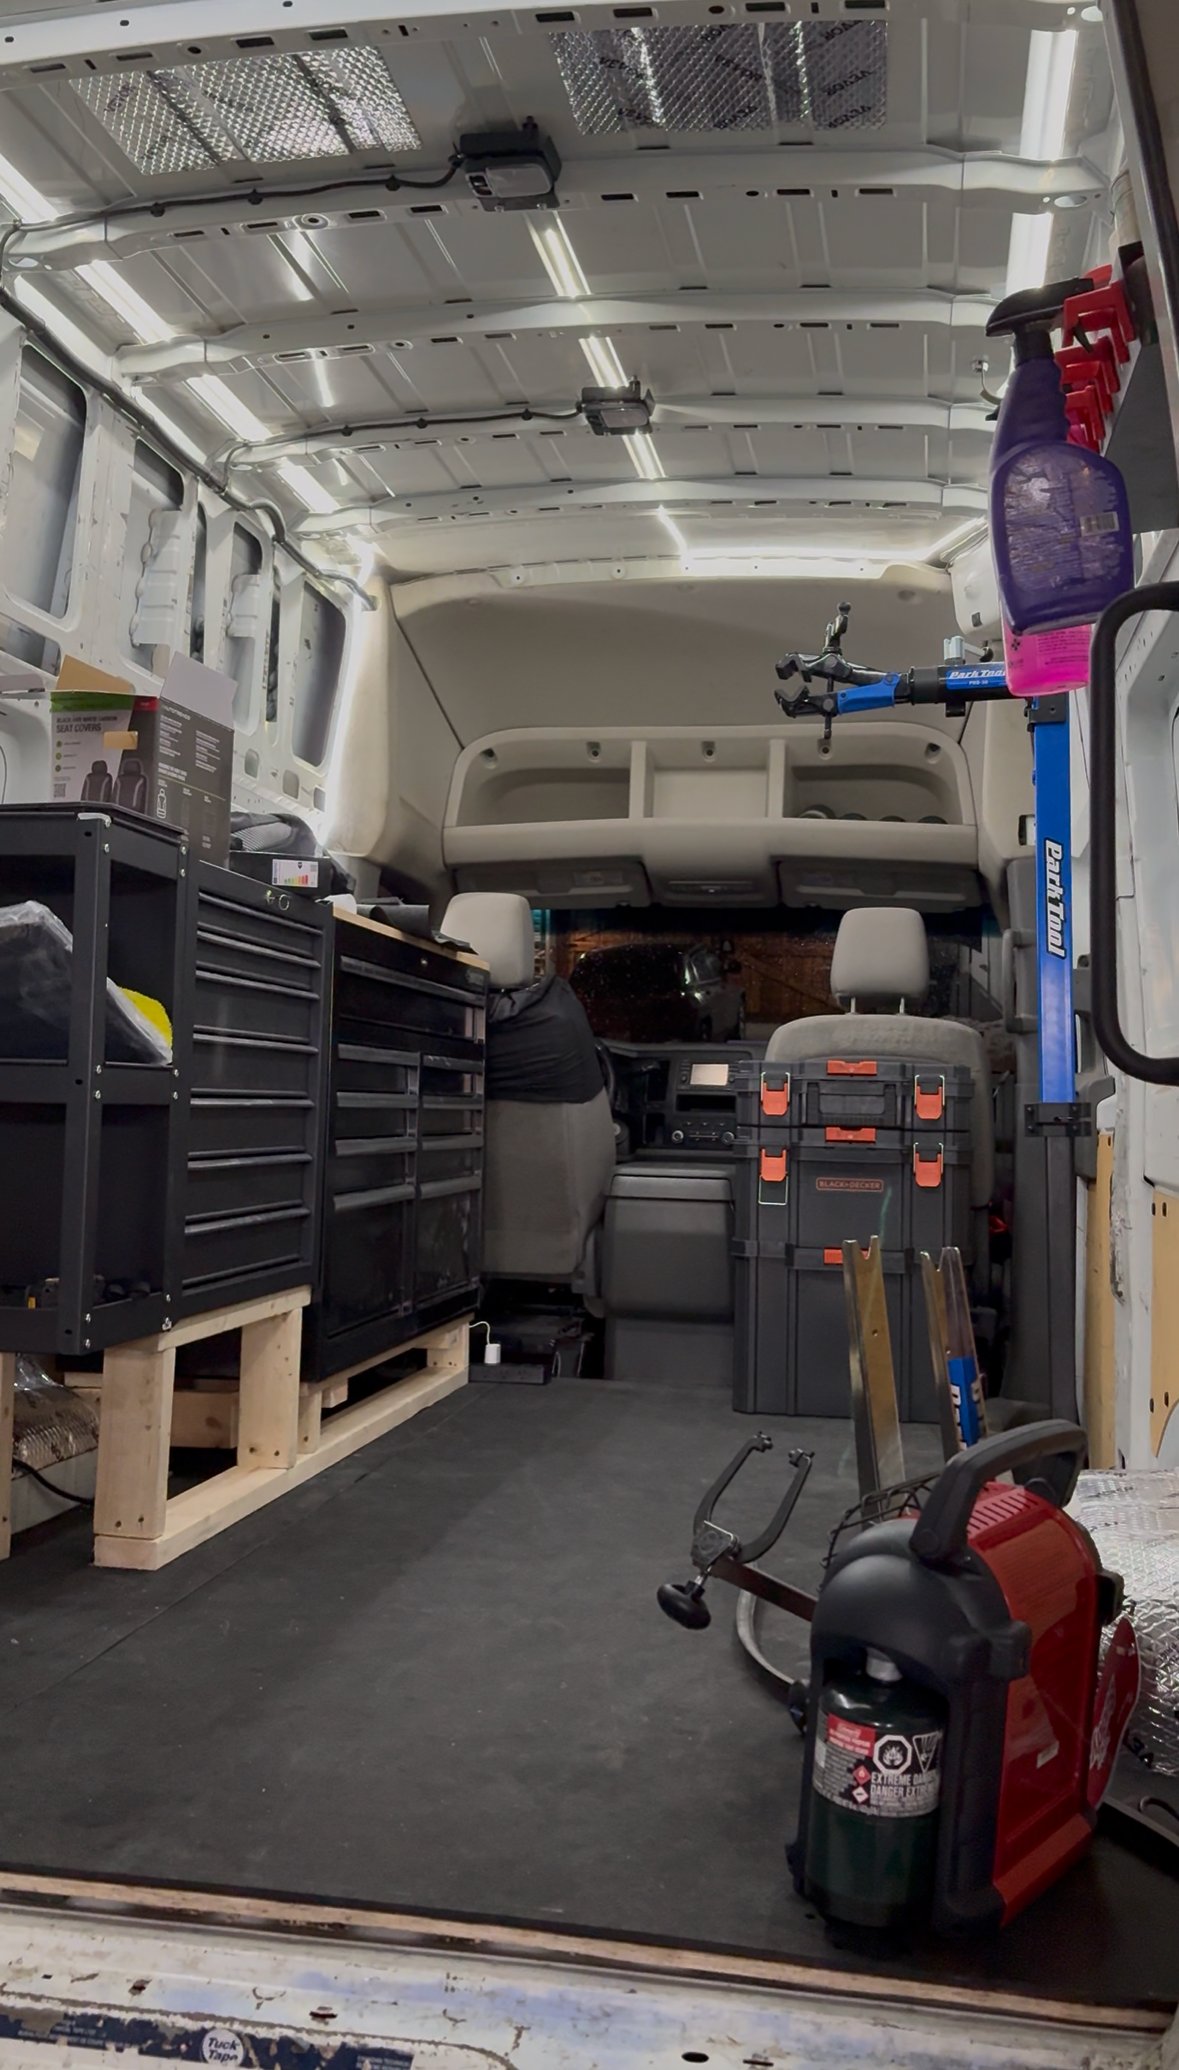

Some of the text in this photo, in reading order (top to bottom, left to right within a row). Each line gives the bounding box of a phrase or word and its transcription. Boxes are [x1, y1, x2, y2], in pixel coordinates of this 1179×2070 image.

[823, 70, 873, 96] VEVOR
[827, 105, 872, 129] VEVOR
[56, 722, 102, 733] SEAT COVERS
[871, 1771, 912, 1786] EXTREME
[870, 1784, 904, 1798] DANGER
[208, 2037, 239, 2050] Tuck
[208, 2049, 239, 2063] Tape
